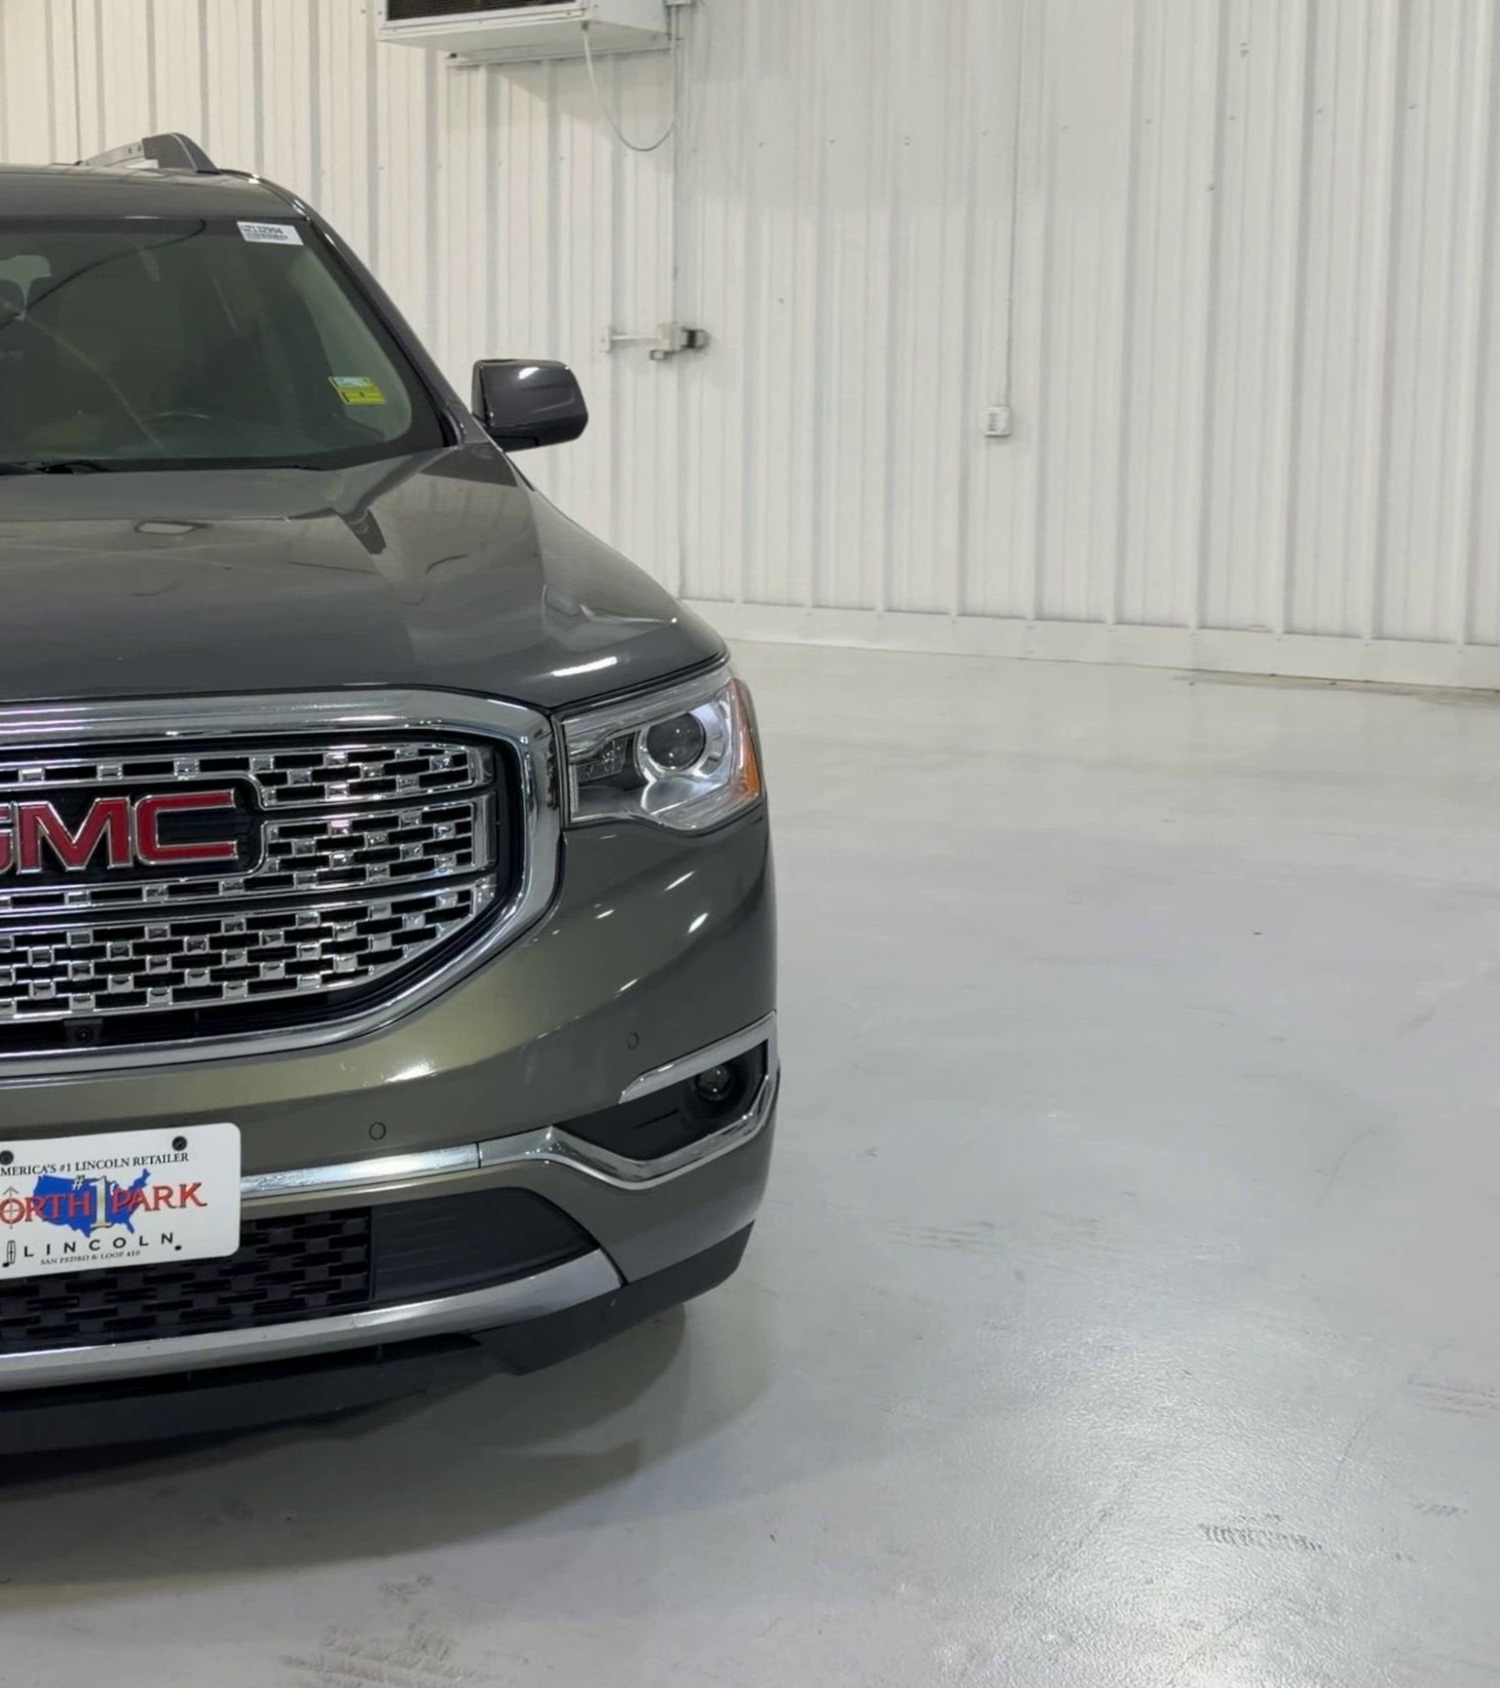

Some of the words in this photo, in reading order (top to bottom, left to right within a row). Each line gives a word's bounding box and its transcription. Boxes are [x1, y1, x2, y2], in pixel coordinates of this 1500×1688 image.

[59, 1163, 71, 1173] #1
[75, 1158, 129, 1171] LINCOLN
[133, 1152, 189, 1167] RETAILER
[112, 1182, 208, 1215] PARK
[24, 1232, 173, 1258] LINCOLN
[40, 1258, 58, 1266] SAN
